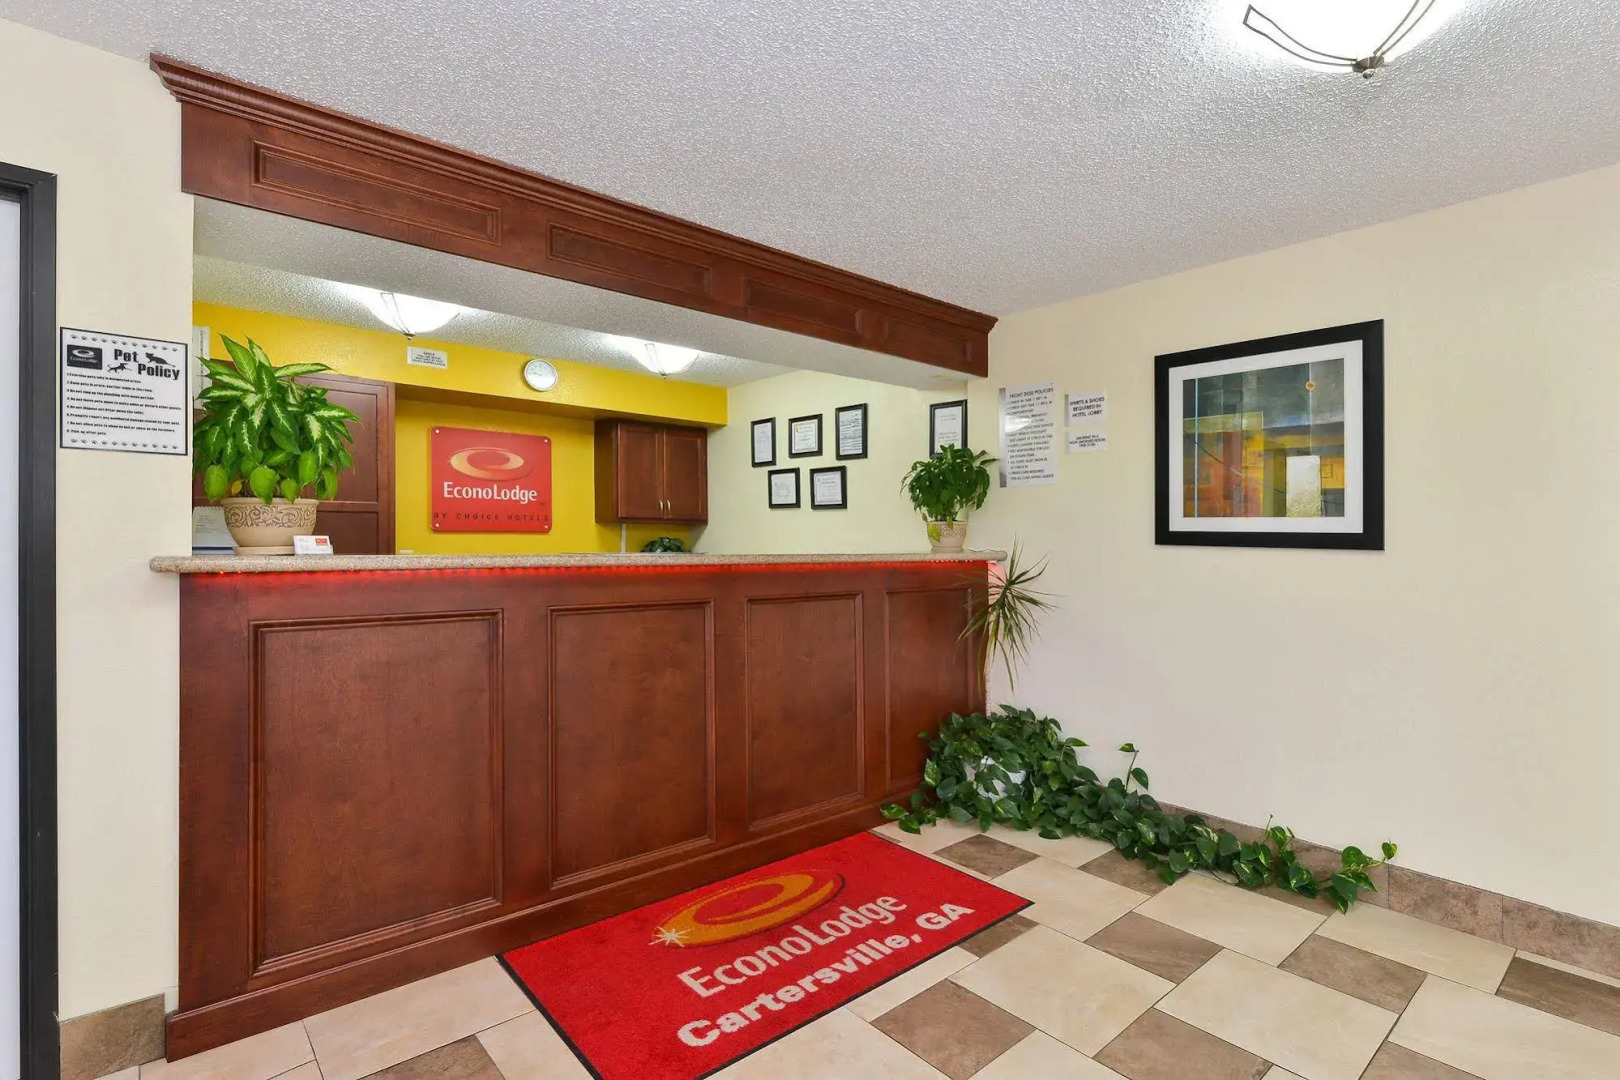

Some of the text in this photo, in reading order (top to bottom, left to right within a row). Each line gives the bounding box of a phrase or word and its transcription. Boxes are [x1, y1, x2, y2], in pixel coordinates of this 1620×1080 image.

[114, 349, 139, 362] Pet
[138, 363, 180, 380] Policy
[444, 481, 538, 504] EconoLodge
[677, 896, 907, 998] EconoLodge
[677, 902, 976, 1048] Cartersville, GA
